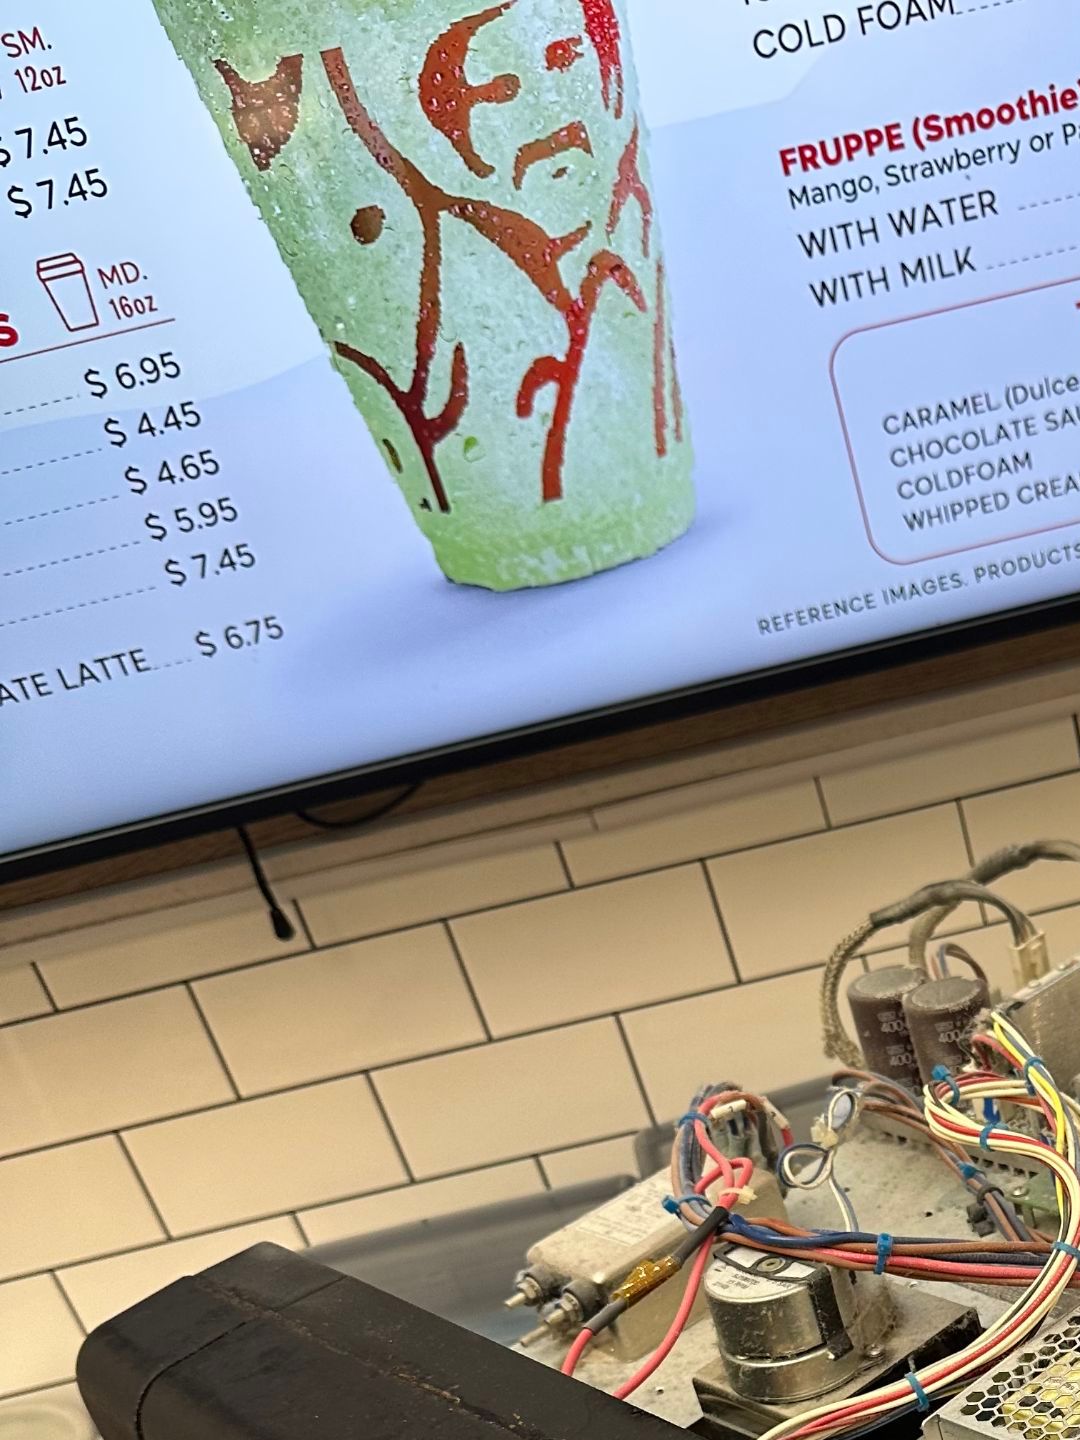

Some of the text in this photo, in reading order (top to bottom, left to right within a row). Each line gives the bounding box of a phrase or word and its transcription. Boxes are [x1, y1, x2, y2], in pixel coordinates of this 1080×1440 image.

[1, 26, 52, 58] SM.
[753, 0, 955, 58] COLD FOAM
[14, 65, 67, 93] 12oz
[15, 116, 87, 159] 7.45
[779, 122, 905, 178] FRUPPE
[36, 168, 108, 210] 7.45
[788, 173, 881, 211] Mango,
[884, 139, 1021, 188] Strawberry
[1029, 130, 1054, 153] or
[797, 217, 880, 259] WITH
[887, 189, 999, 239] WATER
[97, 261, 148, 289] MD.
[808, 266, 890, 308] WITH
[900, 246, 977, 287] MILK
[108, 294, 158, 320] 16oz
[115, 352, 181, 389] 6.95
[137, 401, 201, 437] 4.45
[882, 392, 999, 436] CARAMEL
[1004, 376, 1079, 411] (Dulce
[889, 417, 1038, 468] CHOCOLATE
[157, 450, 220, 485] 4.65
[896, 450, 1033, 501] COLDFOAM
[174, 497, 239, 533] 5.95
[903, 490, 1010, 532] WHIPPED
[191, 543, 256, 579] 7.45
[757, 594, 876, 635] REFERENCE
[56, 648, 152, 691] LATTE
[225, 615, 284, 649] 6.75
